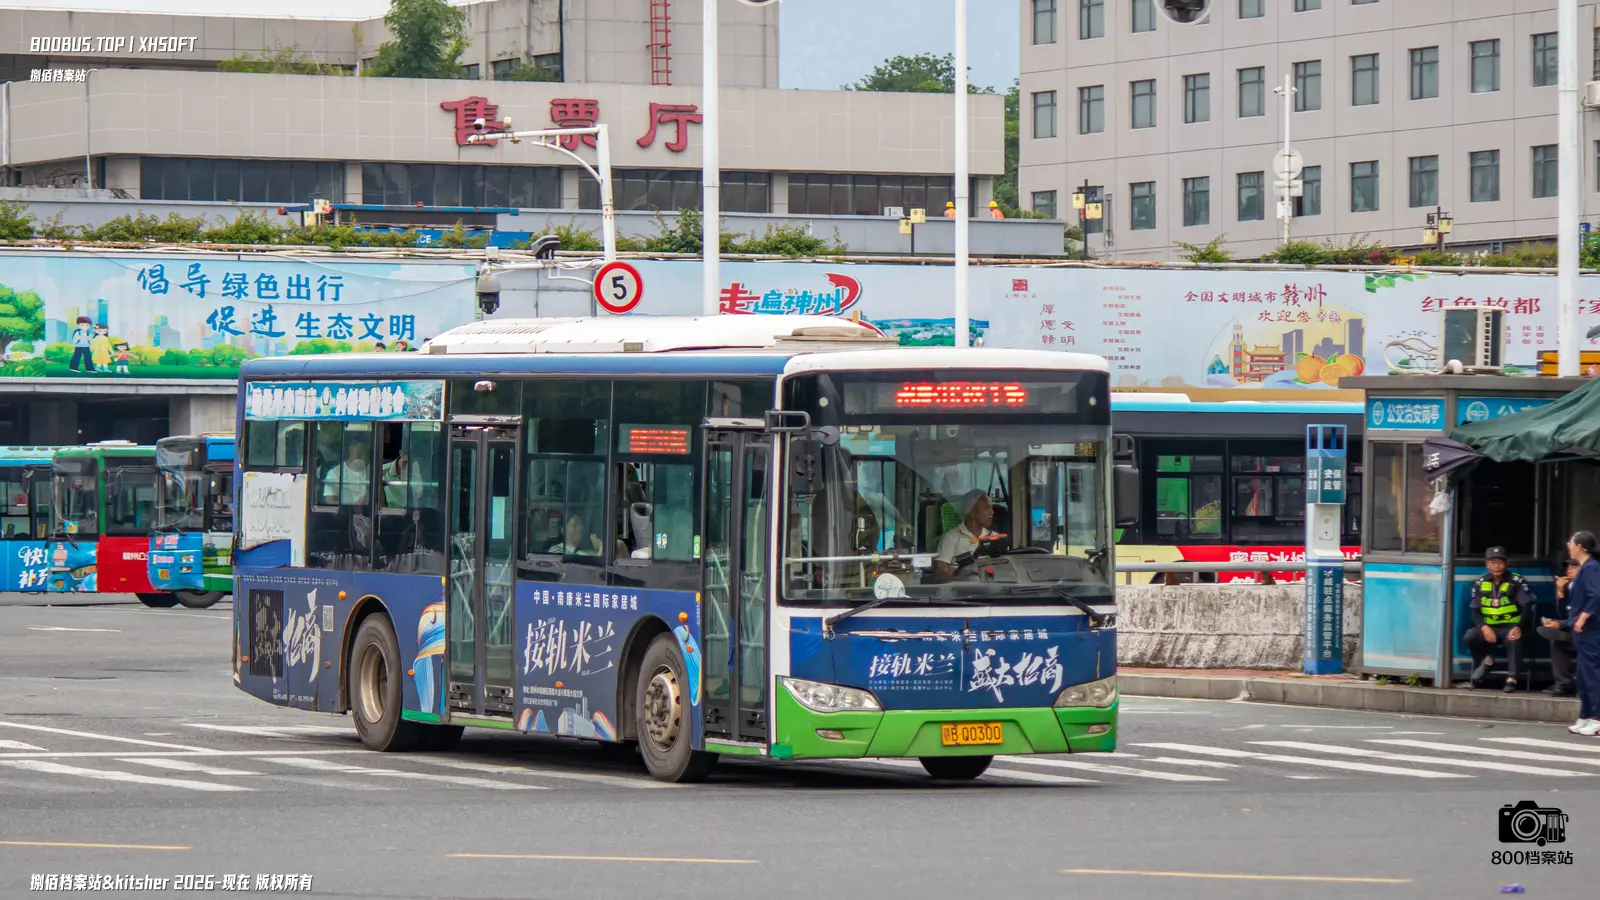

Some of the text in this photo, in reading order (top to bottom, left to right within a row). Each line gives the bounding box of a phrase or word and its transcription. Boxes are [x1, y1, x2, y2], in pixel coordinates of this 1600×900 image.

[440, 95, 703, 152] 售票厅
[137, 262, 344, 301] 倡导绿色出行
[611, 275, 628, 300] 5
[206, 303, 416, 341] 促进生态文明
[1257, 309, 1312, 323] 欢迎您
[1387, 403, 1440, 424] 公交治安岗亭
[1324, 469, 1342, 479] 安保
[1324, 481, 1342, 490] 监管
[524, 619, 615, 676] 接轨米兰
[869, 646, 1063, 703] 接轨米兰 盛大招商
